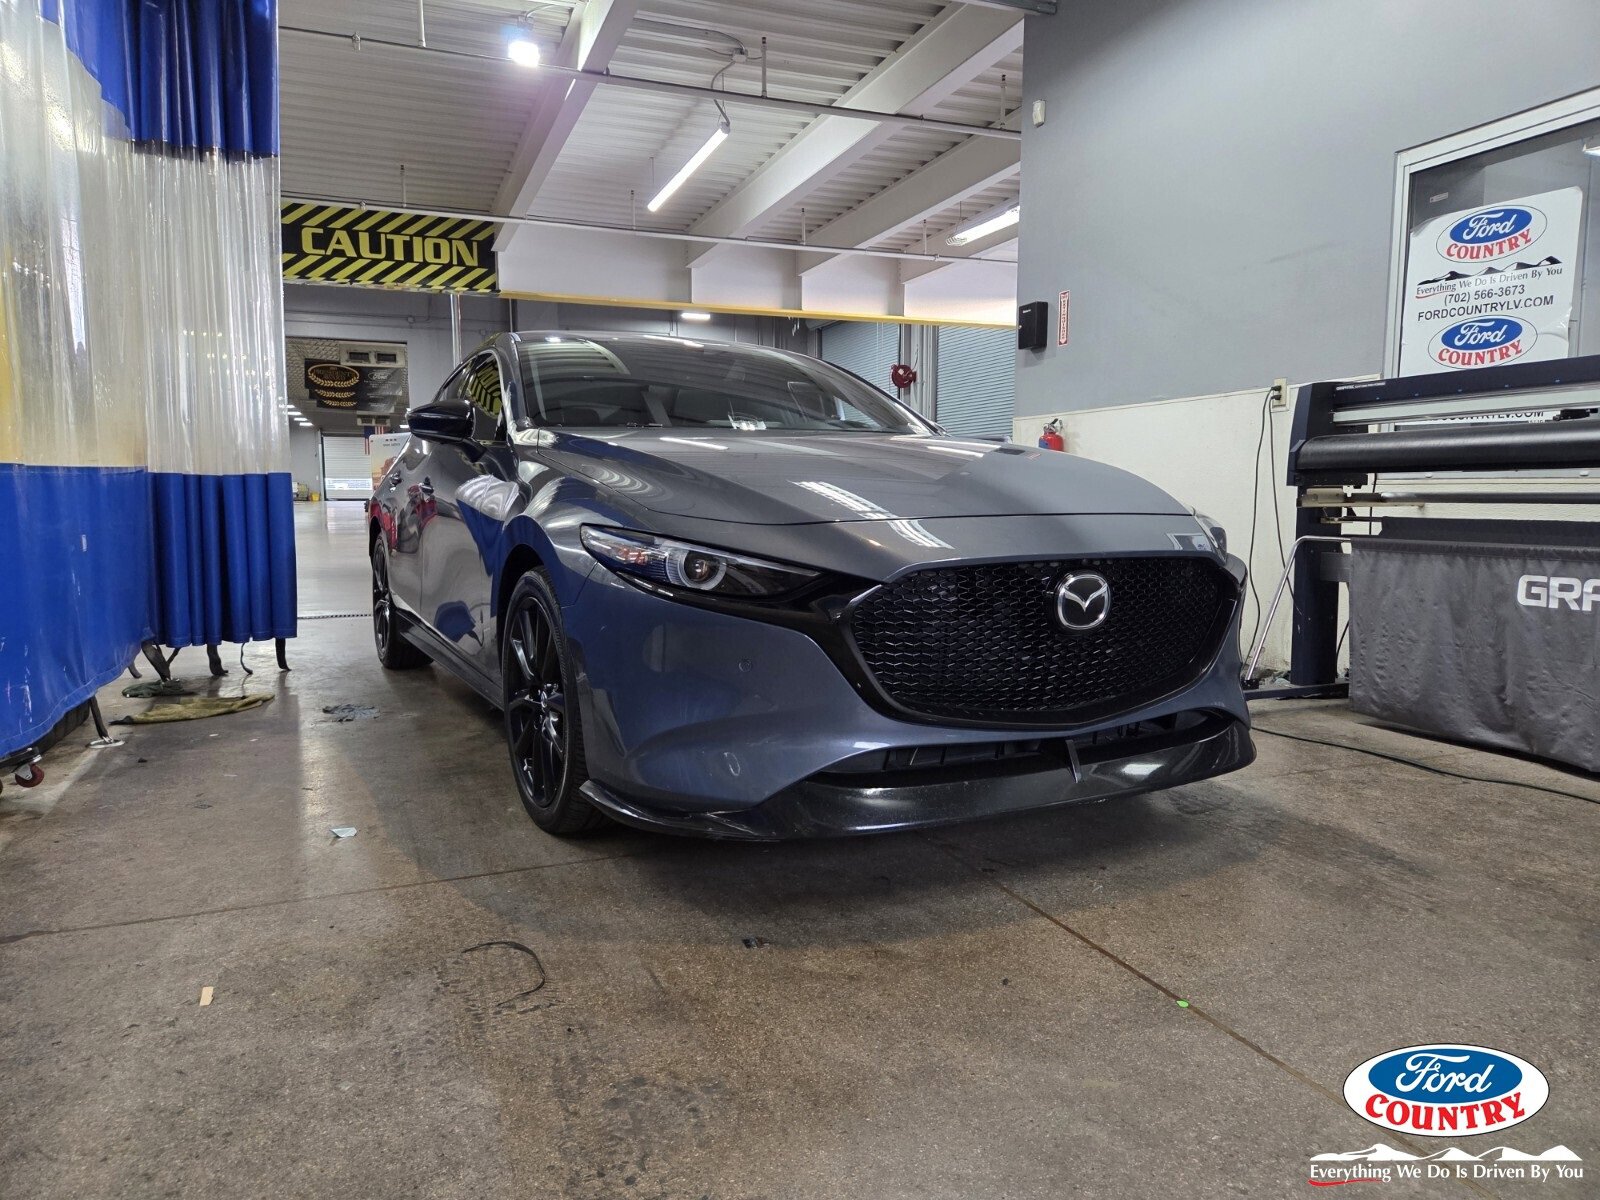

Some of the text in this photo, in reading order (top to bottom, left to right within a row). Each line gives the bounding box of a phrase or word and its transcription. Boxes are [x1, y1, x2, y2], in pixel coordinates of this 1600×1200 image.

[1463, 211, 1517, 241] Ford
[301, 227, 479, 267] CAUTION
[1446, 228, 1532, 260] COUNTRY
[1416, 266, 1563, 297] Everything We Do Is Driven By You
[1444, 284, 1526, 306] (702) 566-3673
[1417, 295, 1554, 322] FORDCOUNTRYLV.COM
[1454, 321, 1508, 346] Ford
[1438, 340, 1522, 366] COUNTRY
